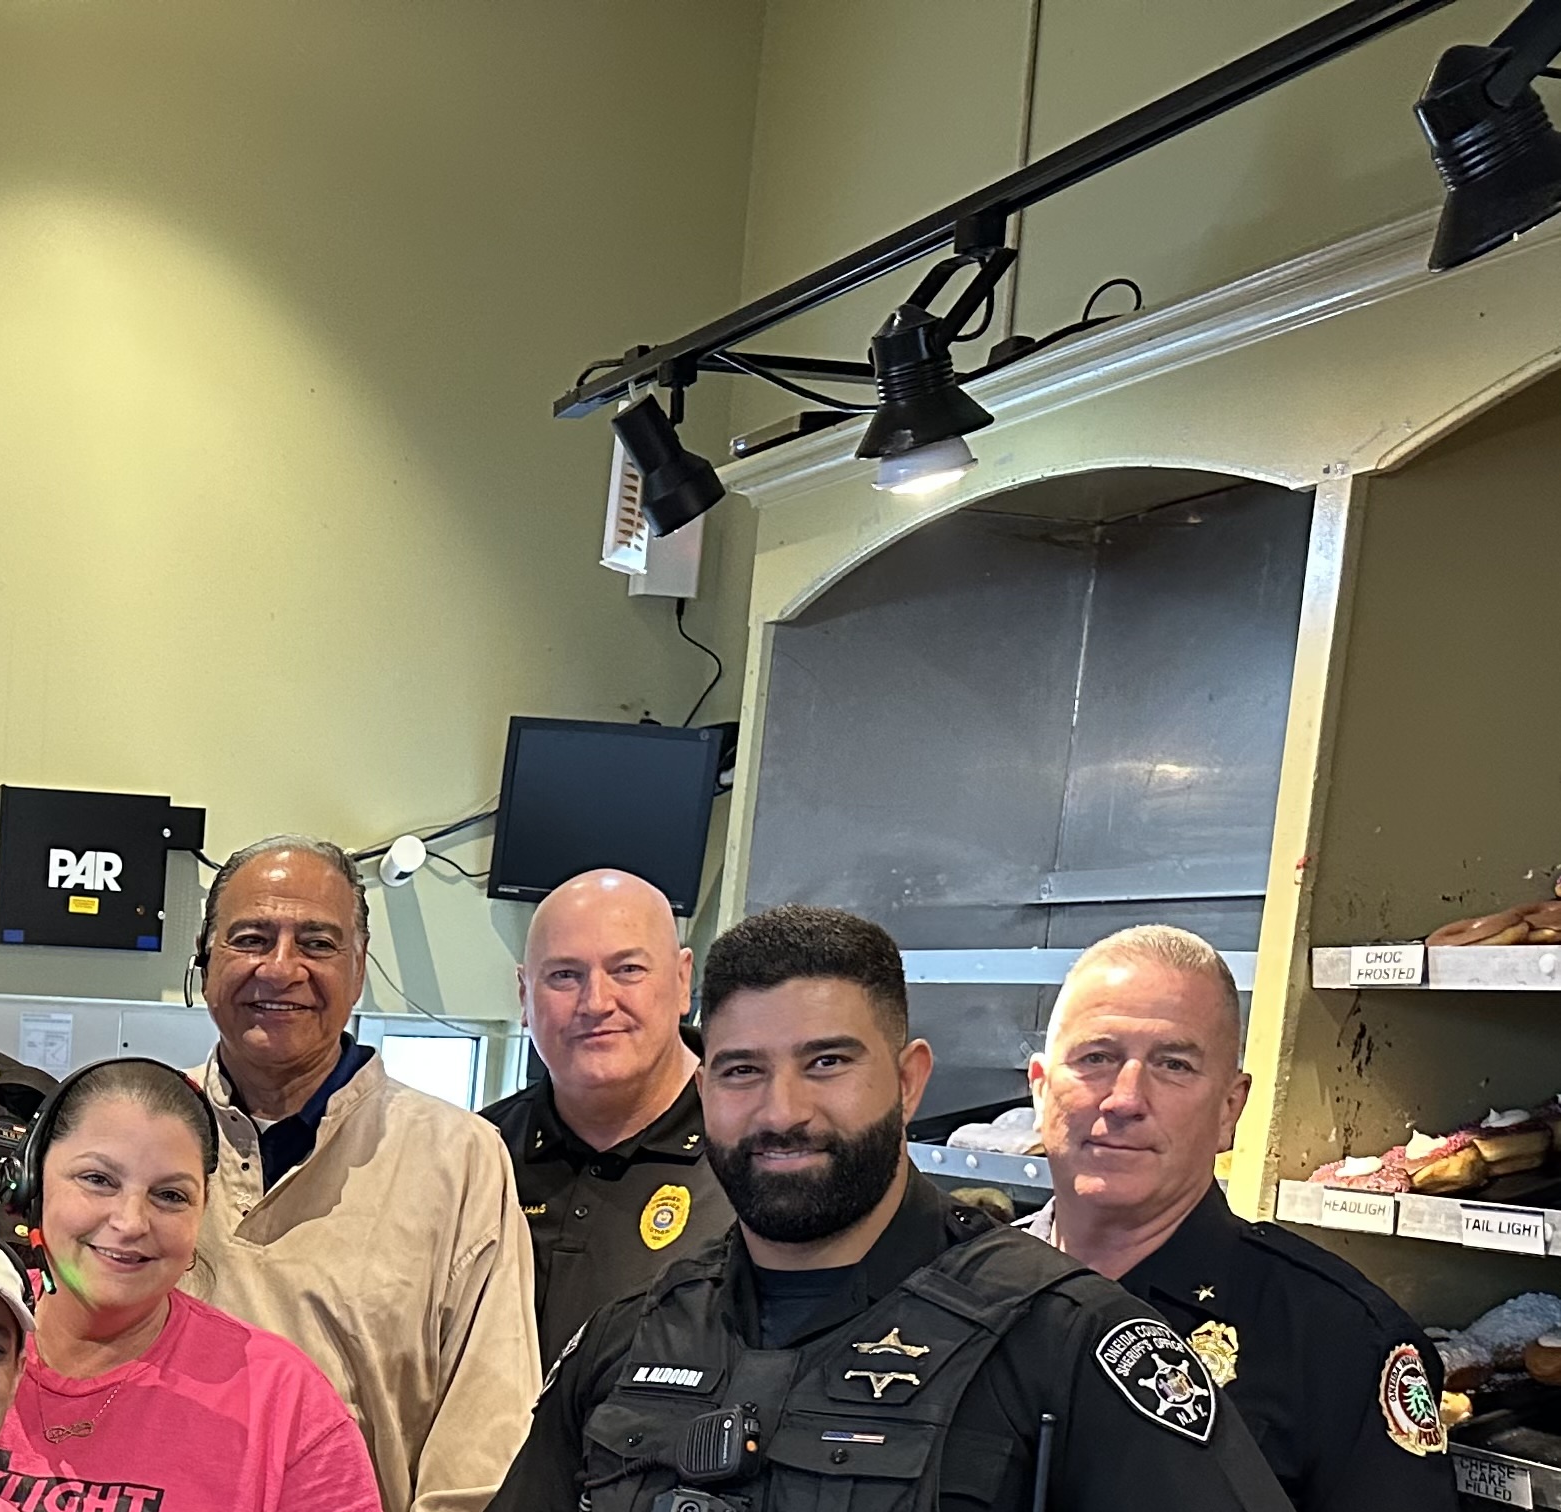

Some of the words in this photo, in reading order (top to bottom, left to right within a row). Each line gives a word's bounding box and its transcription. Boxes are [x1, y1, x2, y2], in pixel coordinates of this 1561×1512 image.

[48, 848, 123, 891] PAR
[1365, 951, 1402, 964] CHOC
[1356, 968, 1415, 980] FROSTED
[1465, 1217, 1492, 1232] TAIL
[1498, 1221, 1540, 1238] LIGHT
[1103, 1329, 1139, 1364] ONEIDA
[1135, 1325, 1171, 1339] COUNTY
[1115, 1339, 1153, 1377] SHERIFF'S
[1152, 1337, 1185, 1354] OFFICE
[1460, 1459, 1516, 1480] CHEESE
[1469, 1470, 1506, 1488] CAKE
[1465, 1480, 1512, 1501] FILLED
